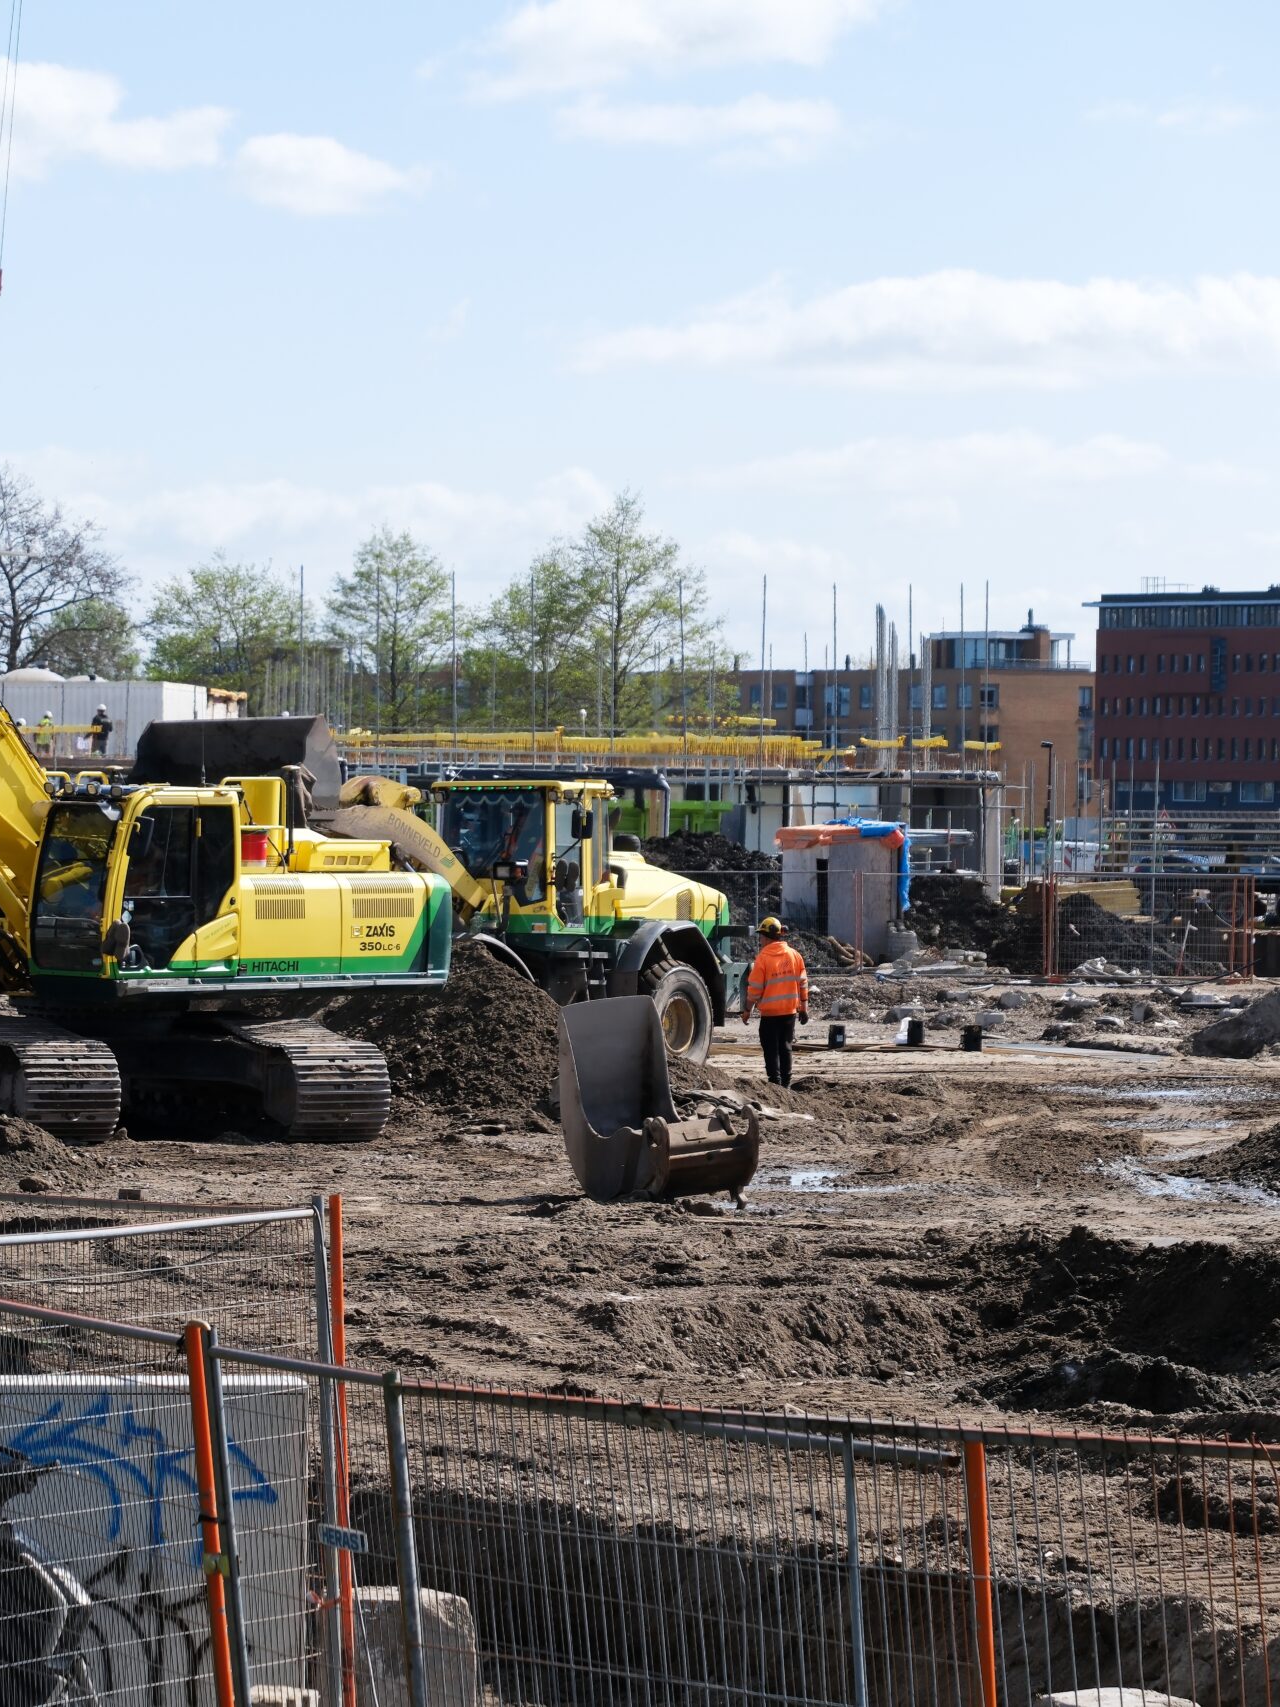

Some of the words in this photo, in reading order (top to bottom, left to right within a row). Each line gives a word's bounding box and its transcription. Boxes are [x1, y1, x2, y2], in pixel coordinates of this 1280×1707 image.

[386, 812, 441, 858] BONNEVELD
[365, 923, 395, 937] ZAXIS
[252, 961, 299, 972] HITACHI
